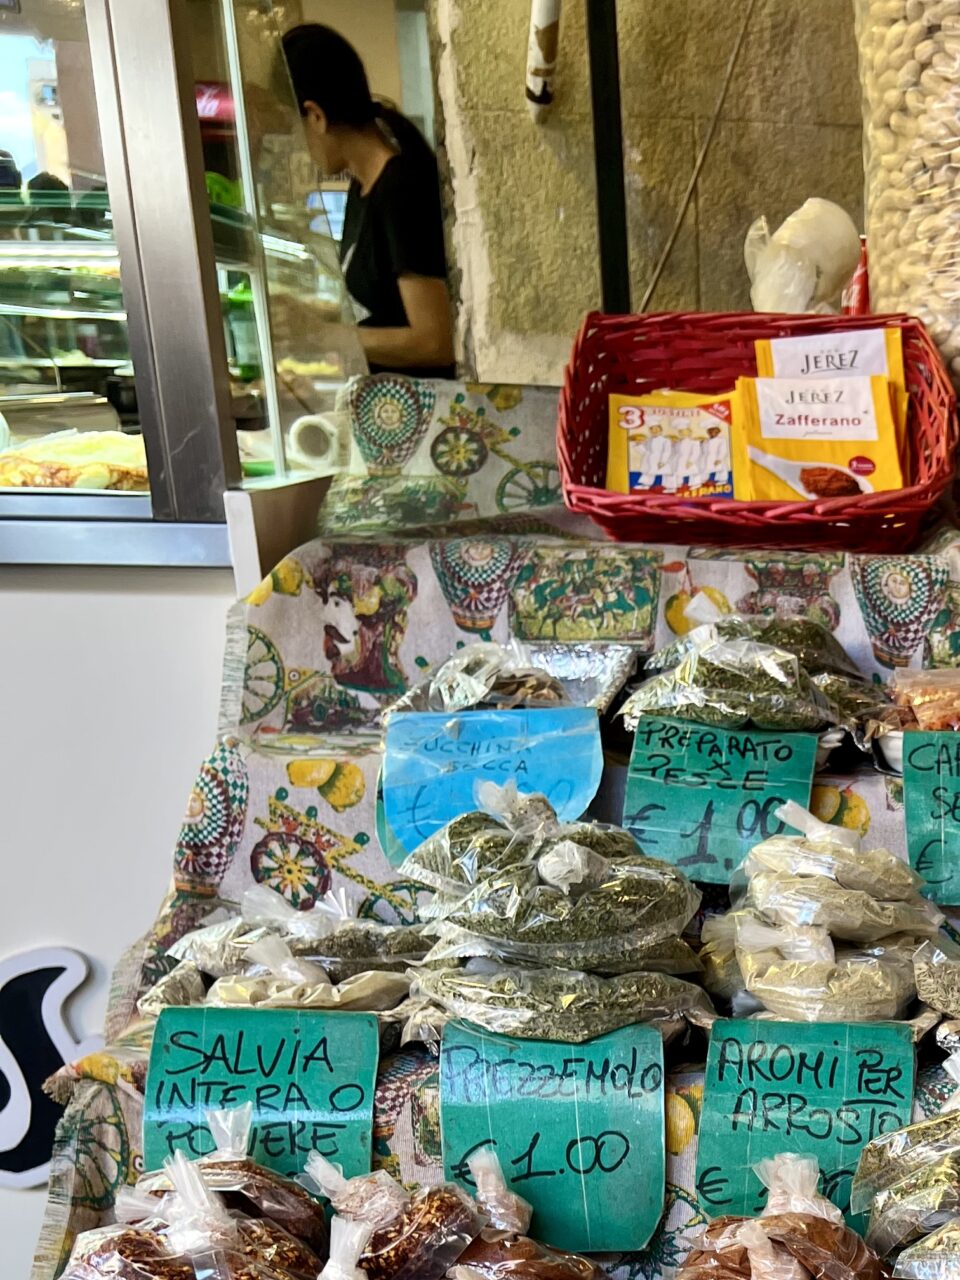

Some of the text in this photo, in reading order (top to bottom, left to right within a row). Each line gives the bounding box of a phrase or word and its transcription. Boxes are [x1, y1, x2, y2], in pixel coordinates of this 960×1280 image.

[800, 349, 859, 375] JEREZ
[618, 406, 644, 429] 3
[785, 390, 844, 405] JEREZ
[775, 413, 862, 427] Zafferano
[639, 721, 793, 762] PREPARATO
[633, 754, 769, 791] PESCE
[624, 803, 666, 844] €
[915, 839, 953, 884] €
[165, 1028, 334, 1078] SALVIA
[717, 1037, 905, 1100] AROMI PER
[155, 1077, 365, 1116] INTERA O
[727, 1087, 903, 1146] ARROSTO
[510, 1130, 631, 1183] 1.00
[696, 1166, 733, 1206] €
